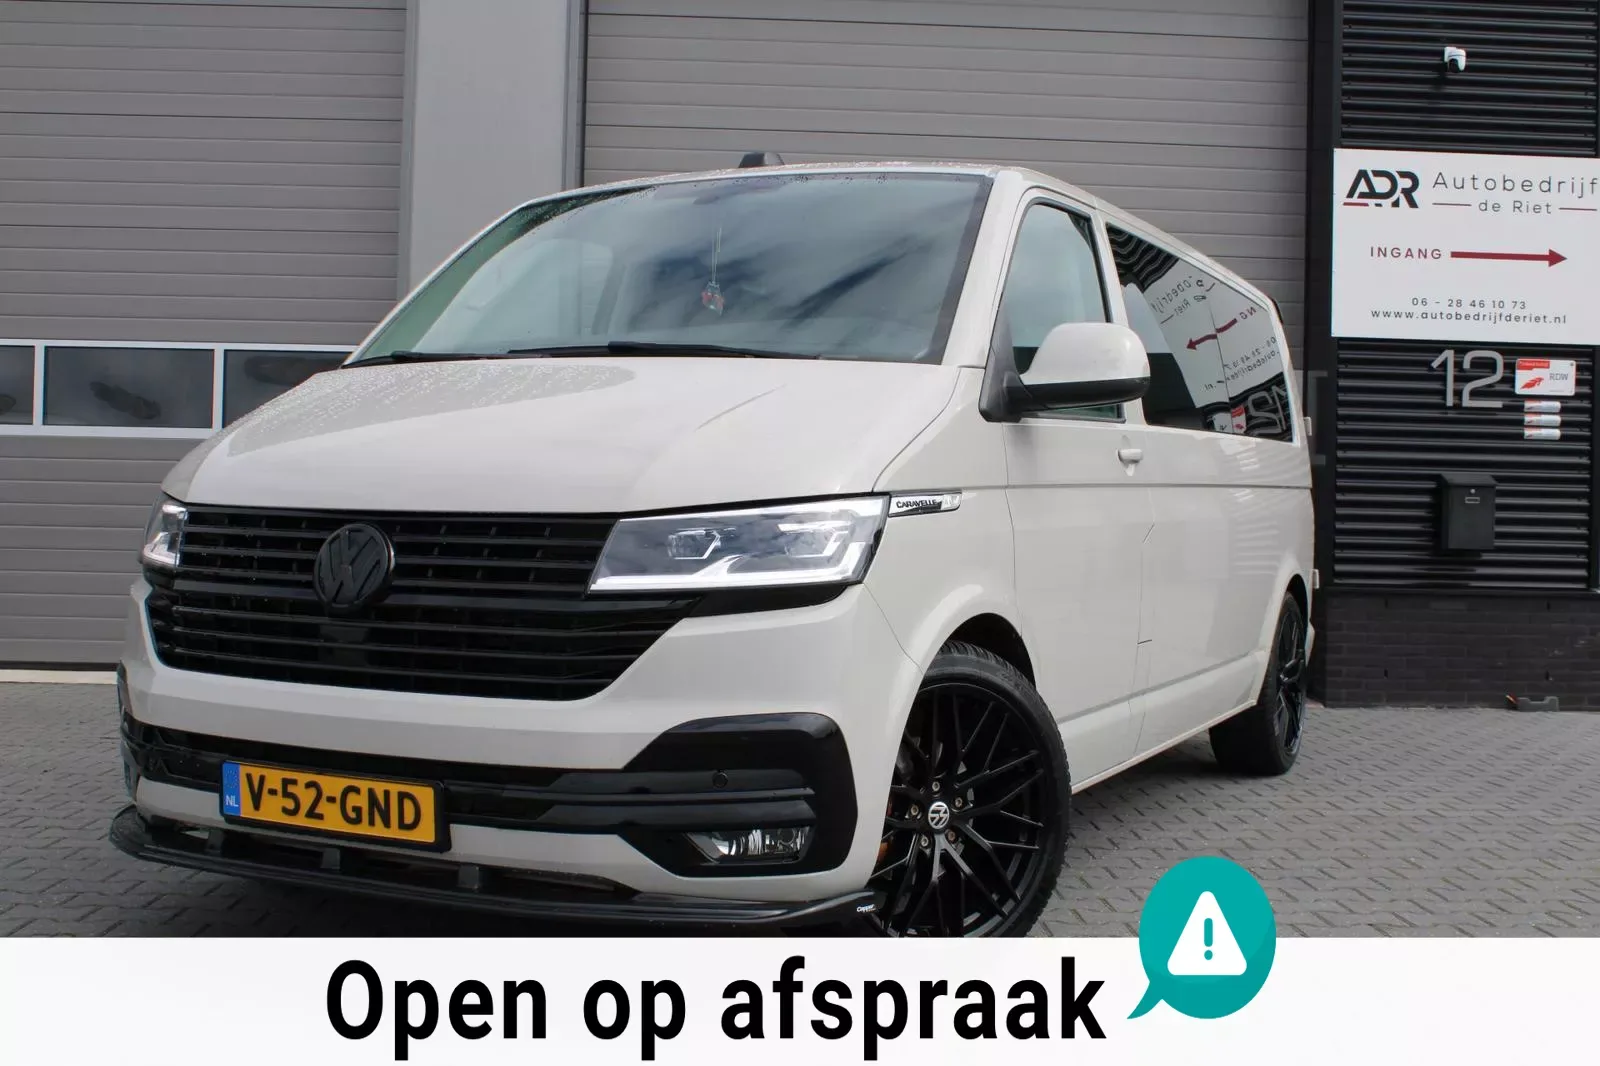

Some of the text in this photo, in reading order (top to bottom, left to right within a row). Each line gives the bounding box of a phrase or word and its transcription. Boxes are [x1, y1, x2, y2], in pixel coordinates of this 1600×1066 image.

[1345, 169, 1420, 209] ADR
[1432, 171, 1599, 199] Autobedrijf
[1478, 200, 1552, 215] de Riet
[1370, 246, 1442, 260] INGANG
[1411, 297, 1428, 307] 06
[1447, 298, 1463, 308] 28
[1469, 299, 1486, 309] 46
[1491, 300, 1505, 309] 10
[1511, 300, 1527, 310] 73
[1430, 349, 1504, 409] 12
[896, 499, 938, 509] CARAVELLE
[225, 794, 239, 808] NL
[245, 772, 422, 831] V-52-GND
